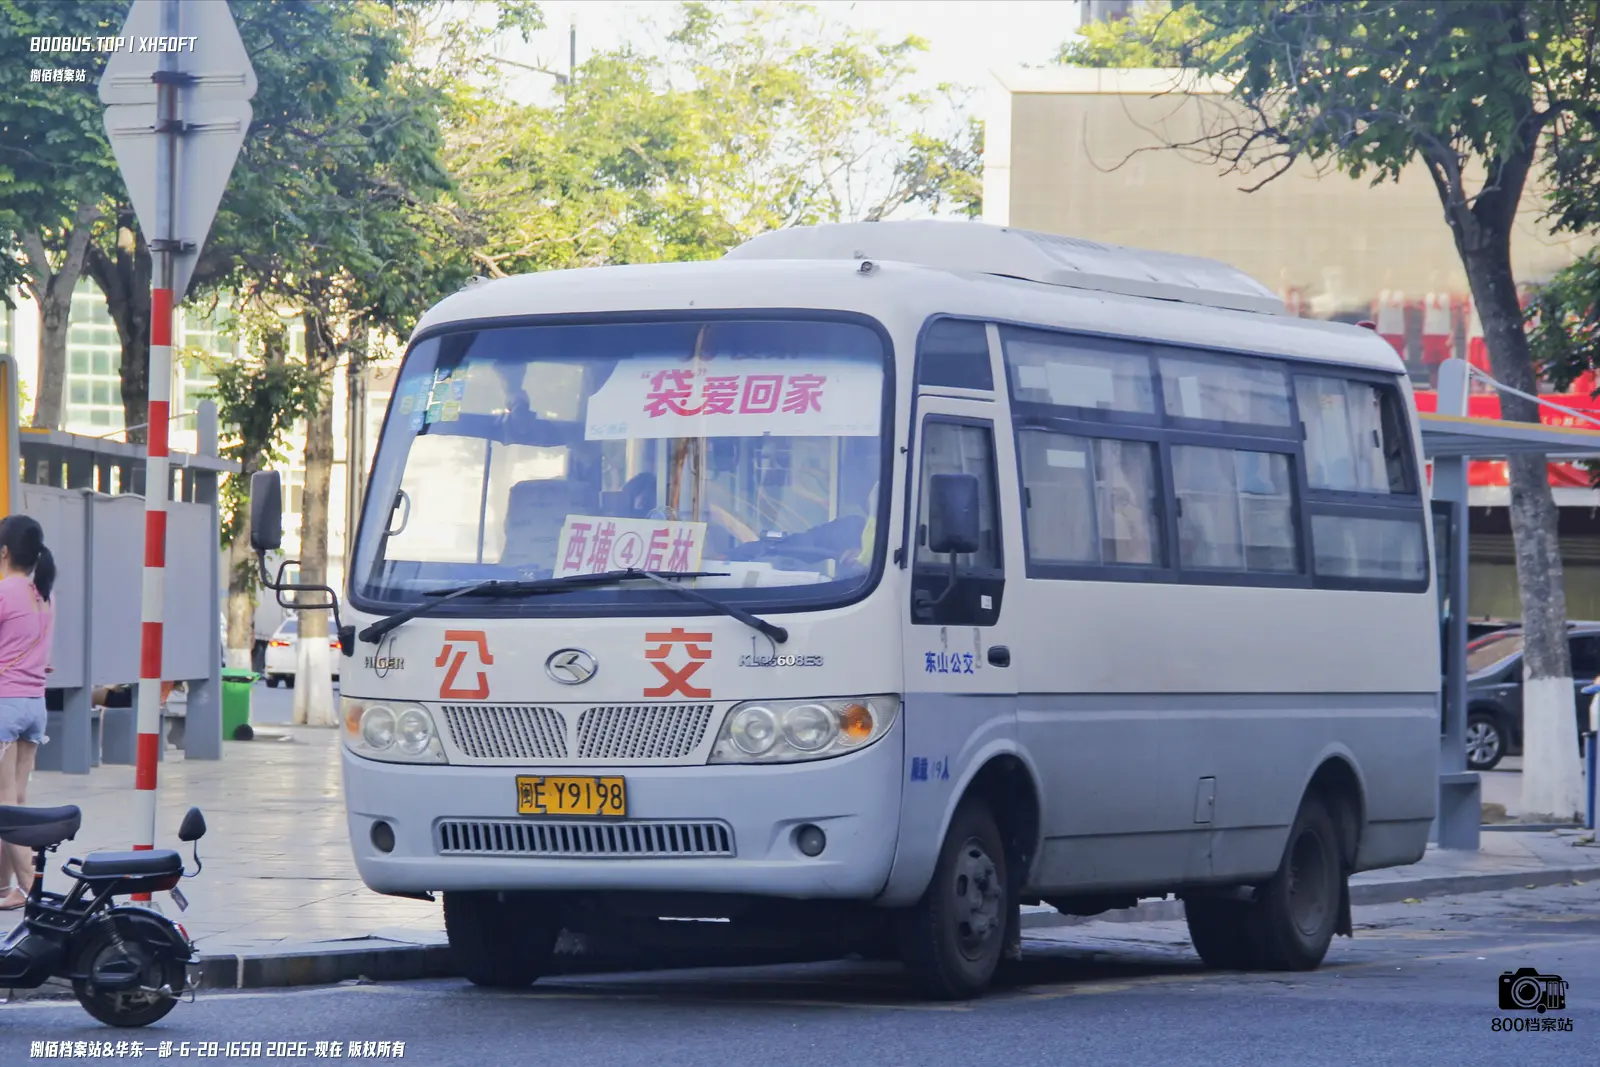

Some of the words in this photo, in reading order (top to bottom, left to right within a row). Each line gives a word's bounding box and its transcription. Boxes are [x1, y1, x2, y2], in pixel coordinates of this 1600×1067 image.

[364, 656, 405, 670] HIGER
[925, 650, 974, 675] 东山公交
